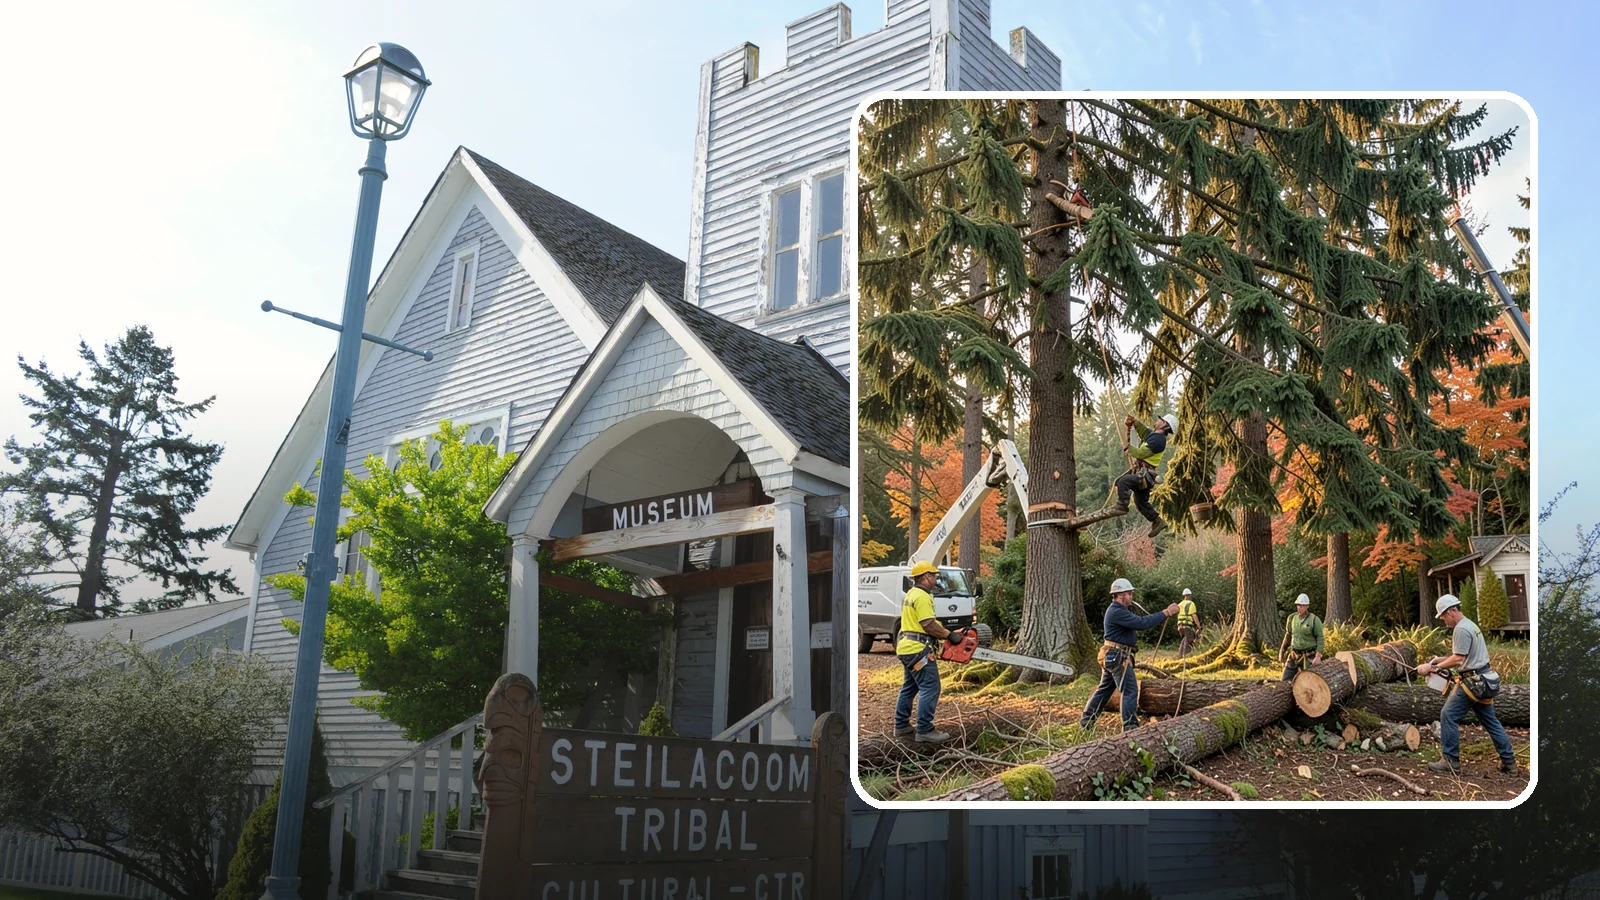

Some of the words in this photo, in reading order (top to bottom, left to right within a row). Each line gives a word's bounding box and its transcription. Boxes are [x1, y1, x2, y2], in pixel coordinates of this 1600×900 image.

[613, 492, 713, 530] MUSEUM
[551, 738, 809, 792] STEILACOOM
[614, 806, 758, 851] TRIBAL
